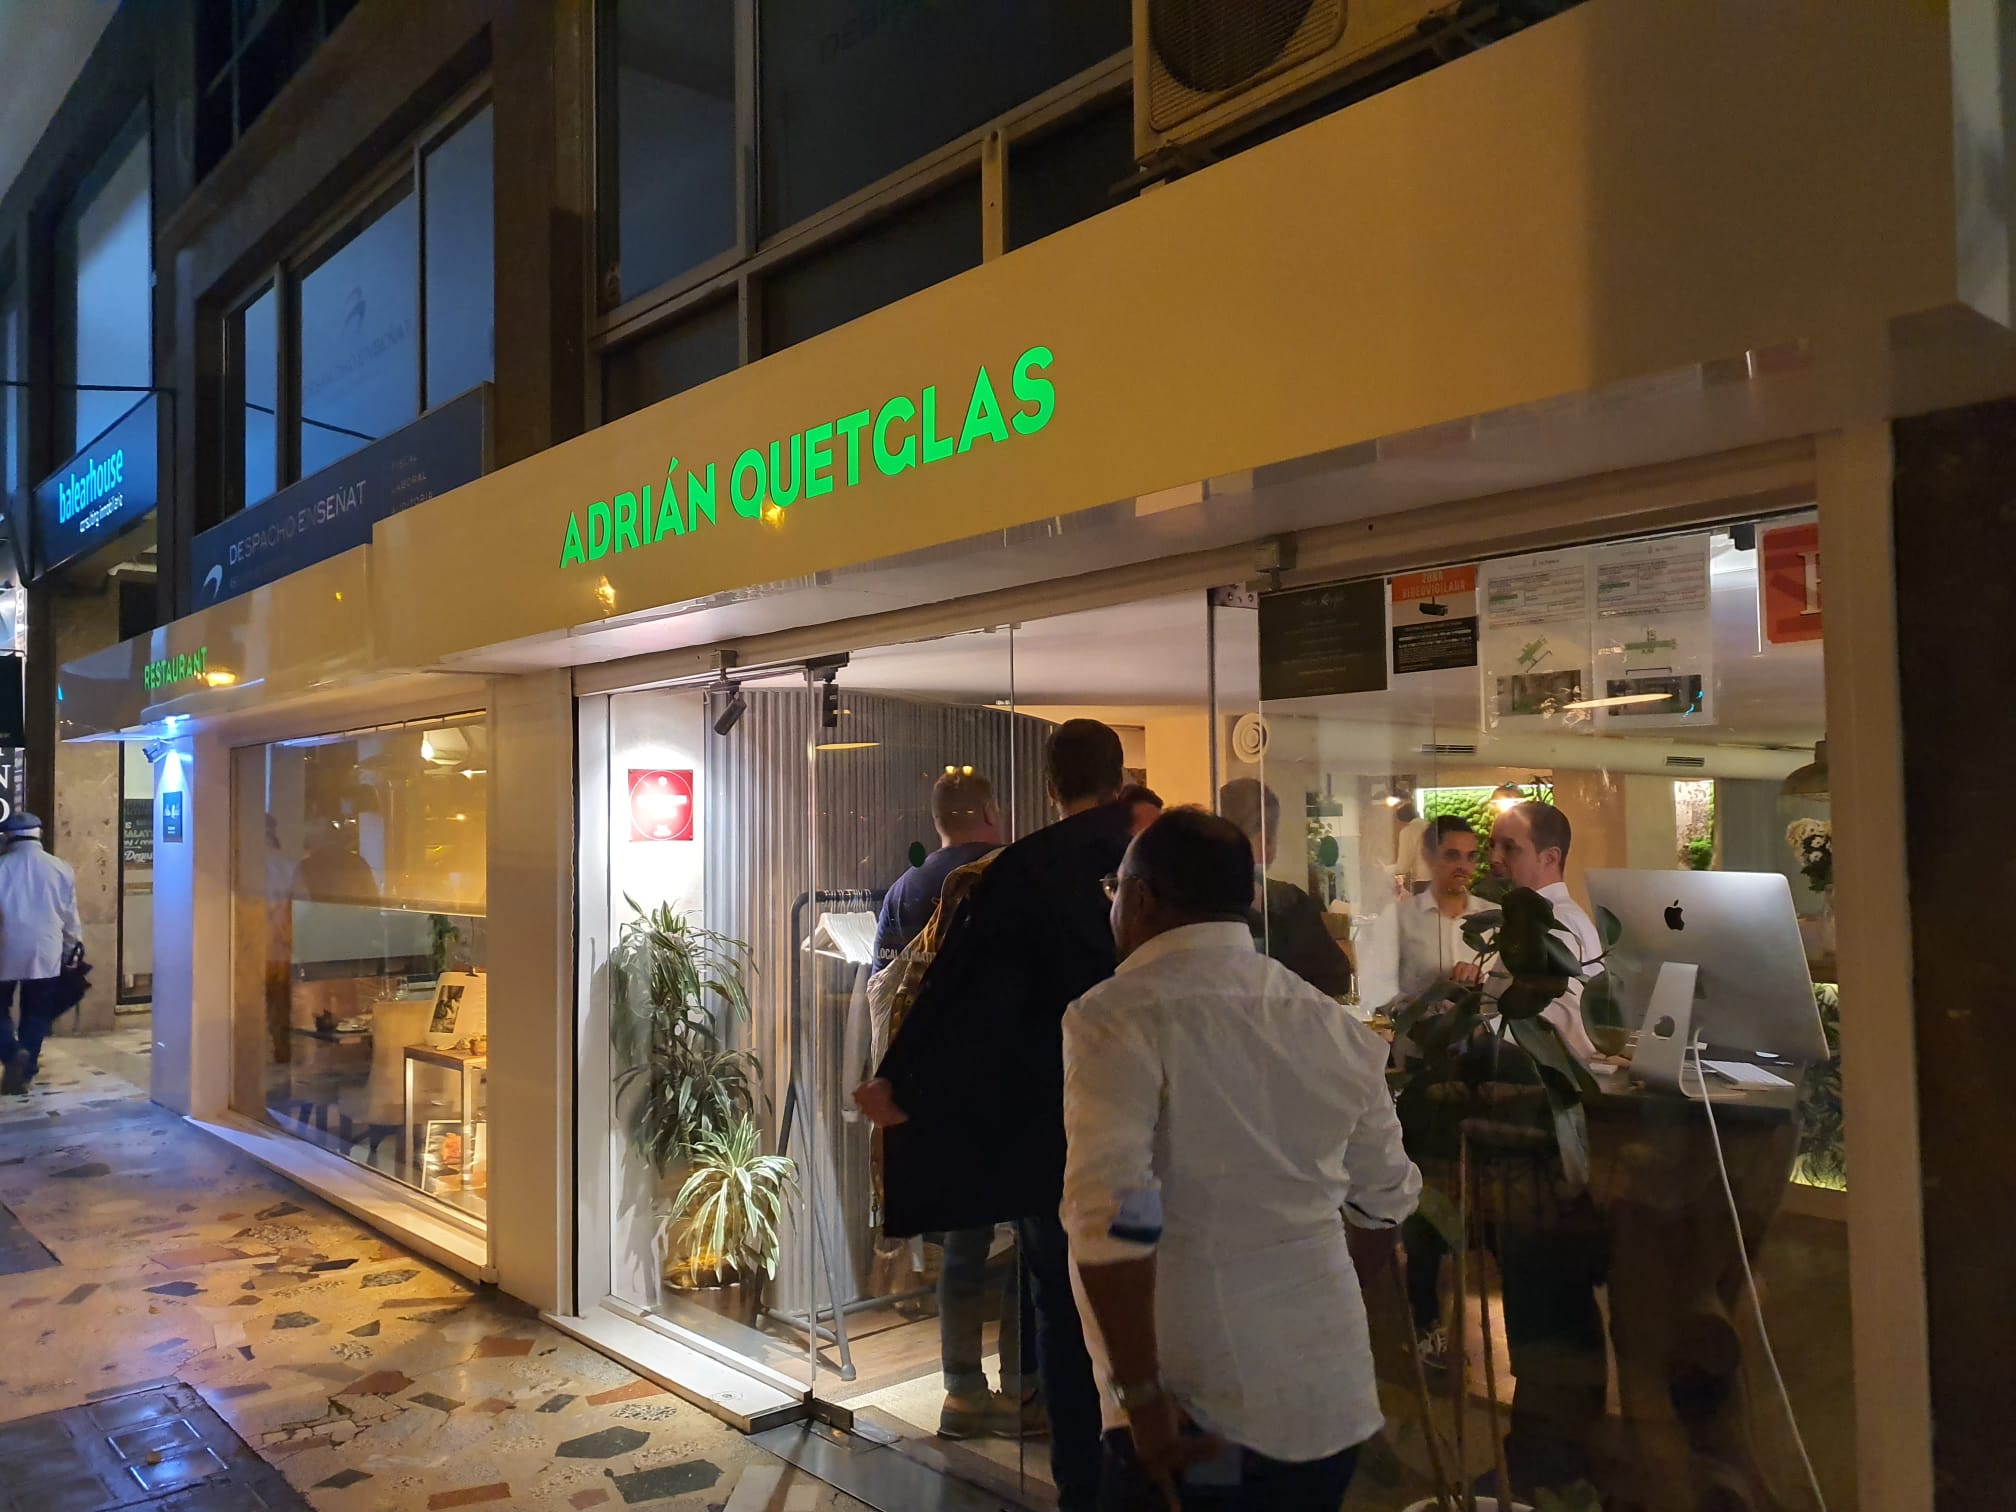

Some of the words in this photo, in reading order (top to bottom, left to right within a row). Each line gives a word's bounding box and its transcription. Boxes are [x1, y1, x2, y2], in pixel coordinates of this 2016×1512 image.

[59, 449, 123, 524] balearhouse
[560, 456, 716, 568] ADRIÁN
[729, 345, 1056, 519] QUETGLAS
[229, 515, 295, 566] DESPACHO
[298, 480, 367, 532] ENSEÑAT
[144, 646, 208, 691] RESTAURANT
